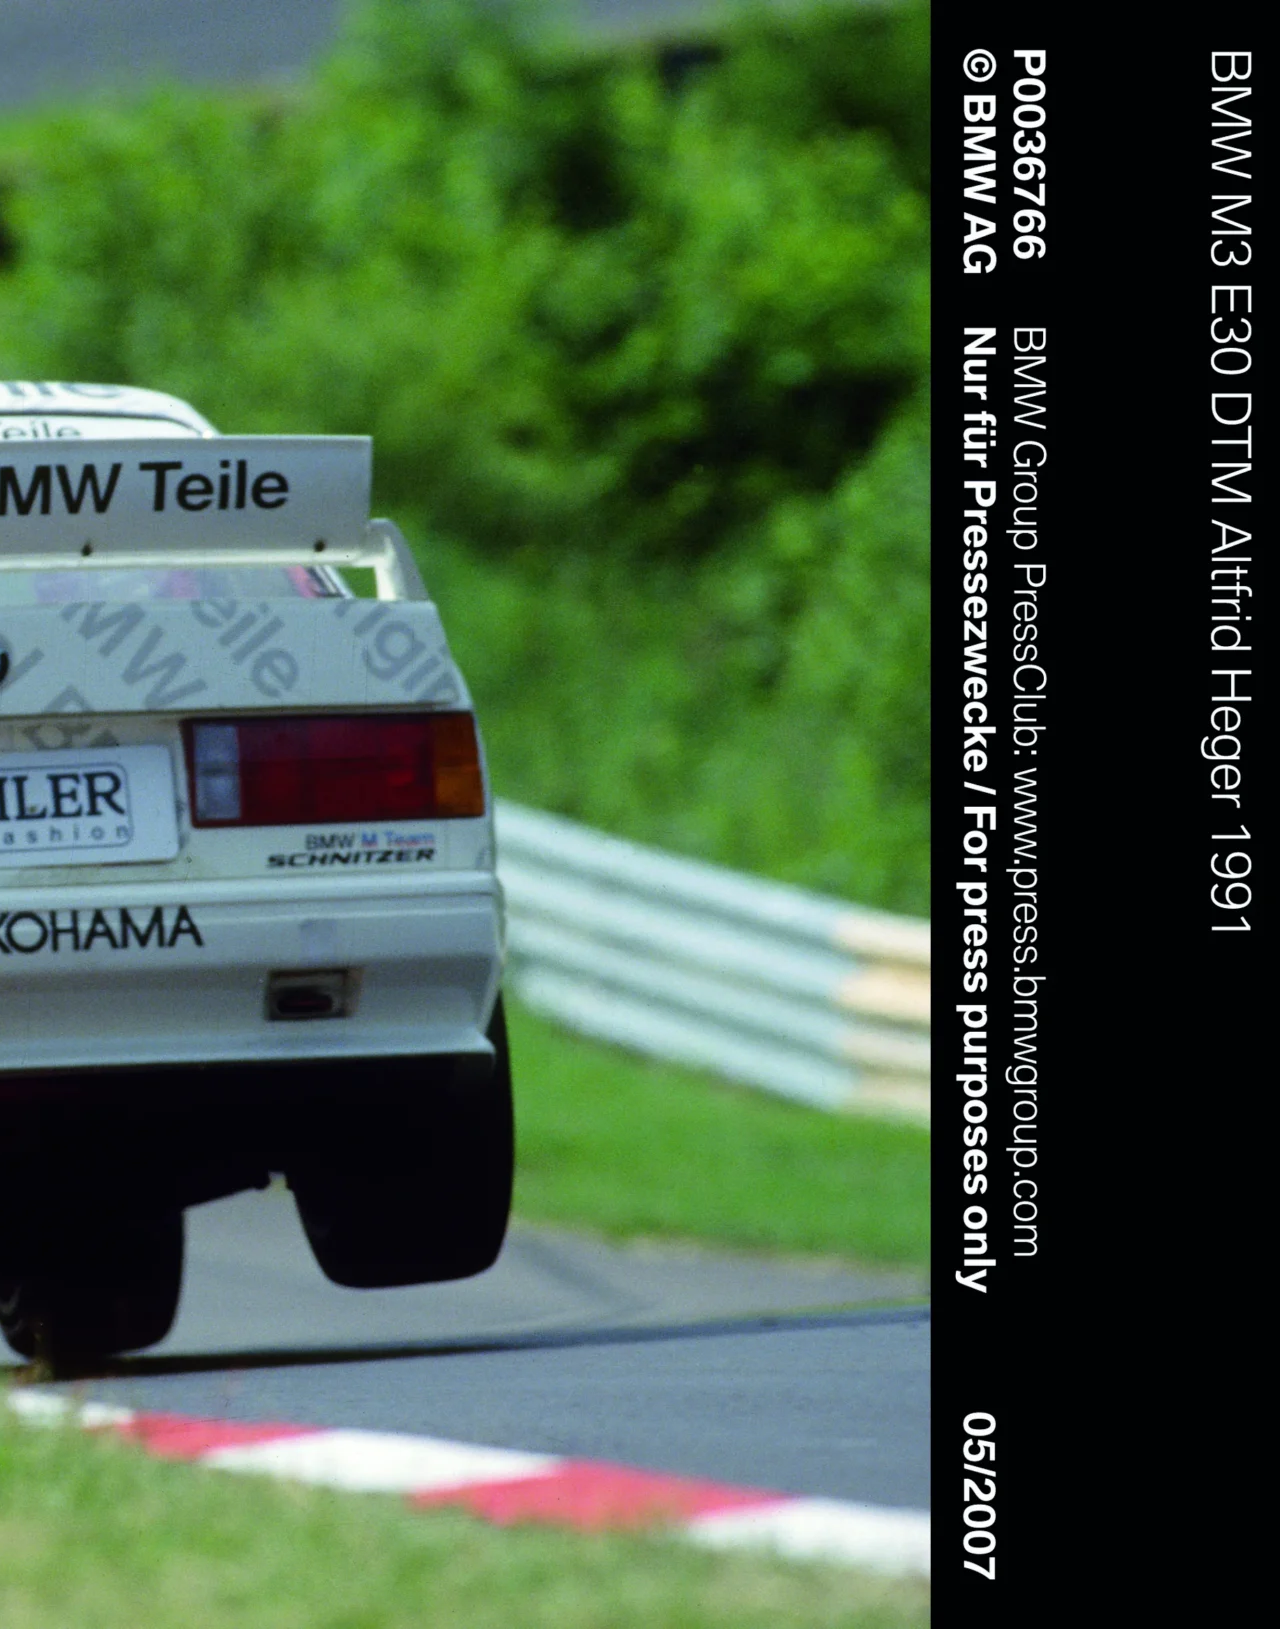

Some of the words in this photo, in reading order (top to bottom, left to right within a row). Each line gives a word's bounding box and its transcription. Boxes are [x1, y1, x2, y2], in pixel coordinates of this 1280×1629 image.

[138, 458, 291, 513] Teile
[305, 832, 356, 851] BMW
[361, 832, 379, 849] M
[384, 830, 436, 848] Team
[267, 848, 437, 869] SCHNITZER
